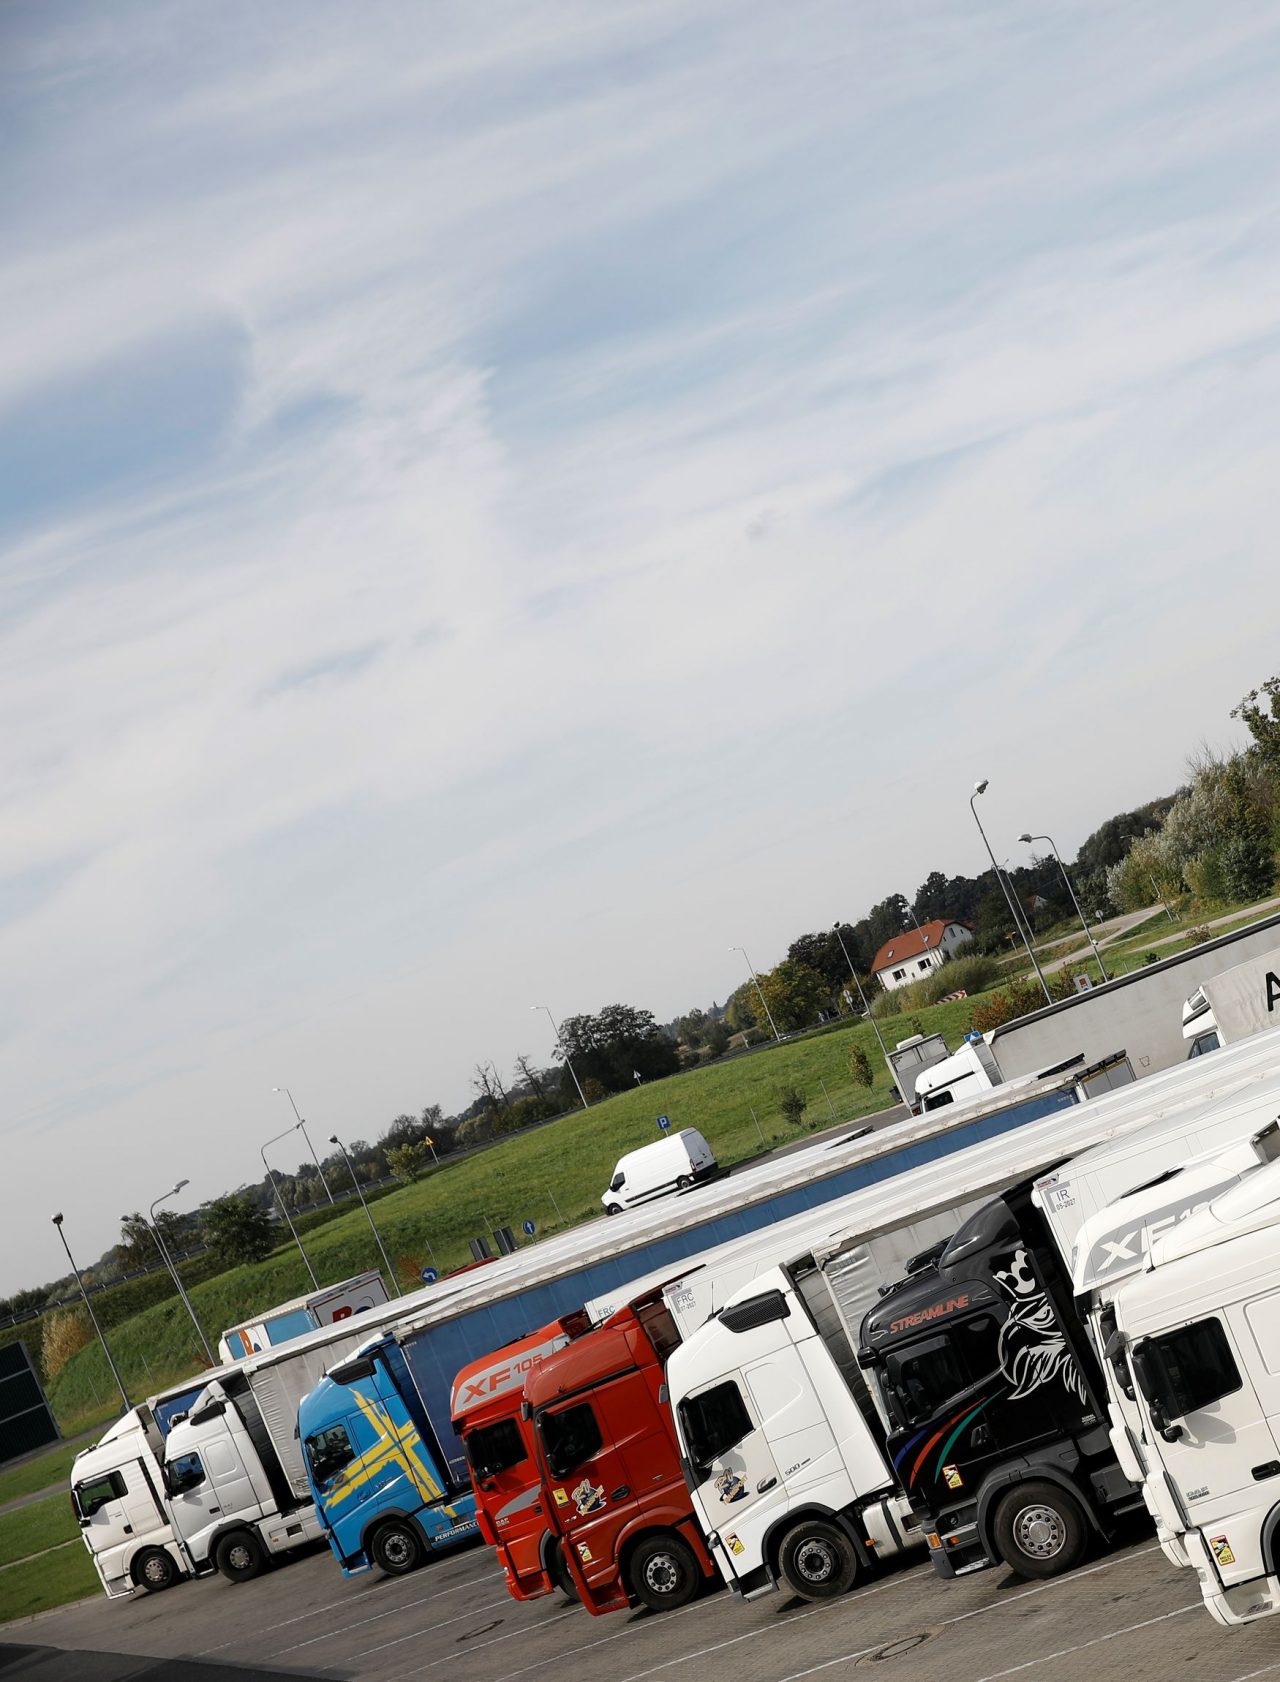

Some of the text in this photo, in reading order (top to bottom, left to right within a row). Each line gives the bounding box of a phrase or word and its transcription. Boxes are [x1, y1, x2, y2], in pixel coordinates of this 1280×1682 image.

[660, 1117, 668, 1128] P
[1056, 1189, 1070, 1201] IR
[676, 1292, 695, 1305] FRC
[598, 1306, 616, 1318] FRC
[890, 1295, 969, 1334] STREAMLINE
[784, 1463, 801, 1476] 500
